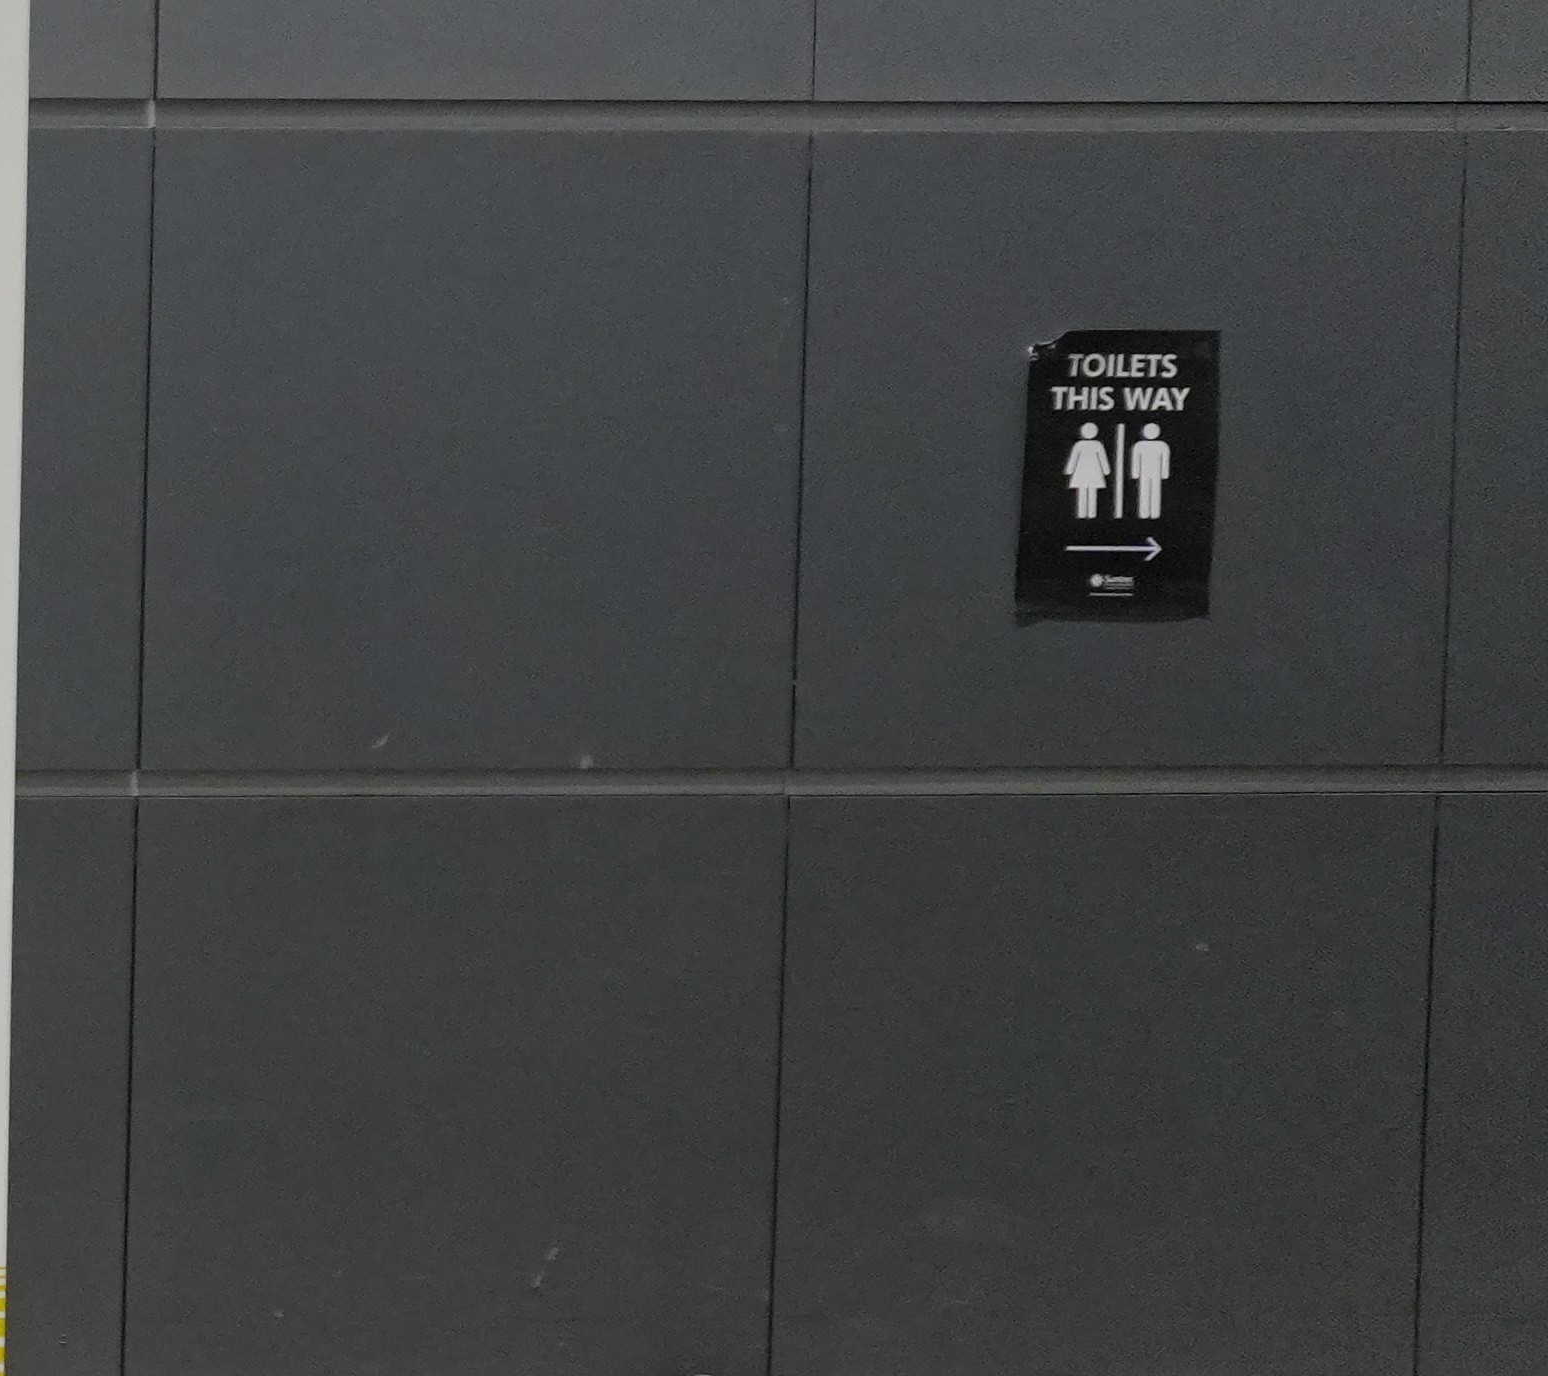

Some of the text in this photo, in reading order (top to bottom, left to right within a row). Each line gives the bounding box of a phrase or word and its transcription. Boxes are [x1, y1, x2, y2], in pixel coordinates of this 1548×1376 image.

[1068, 353, 1178, 378] TOILETS
[1051, 386, 1191, 411] THIS WAY
